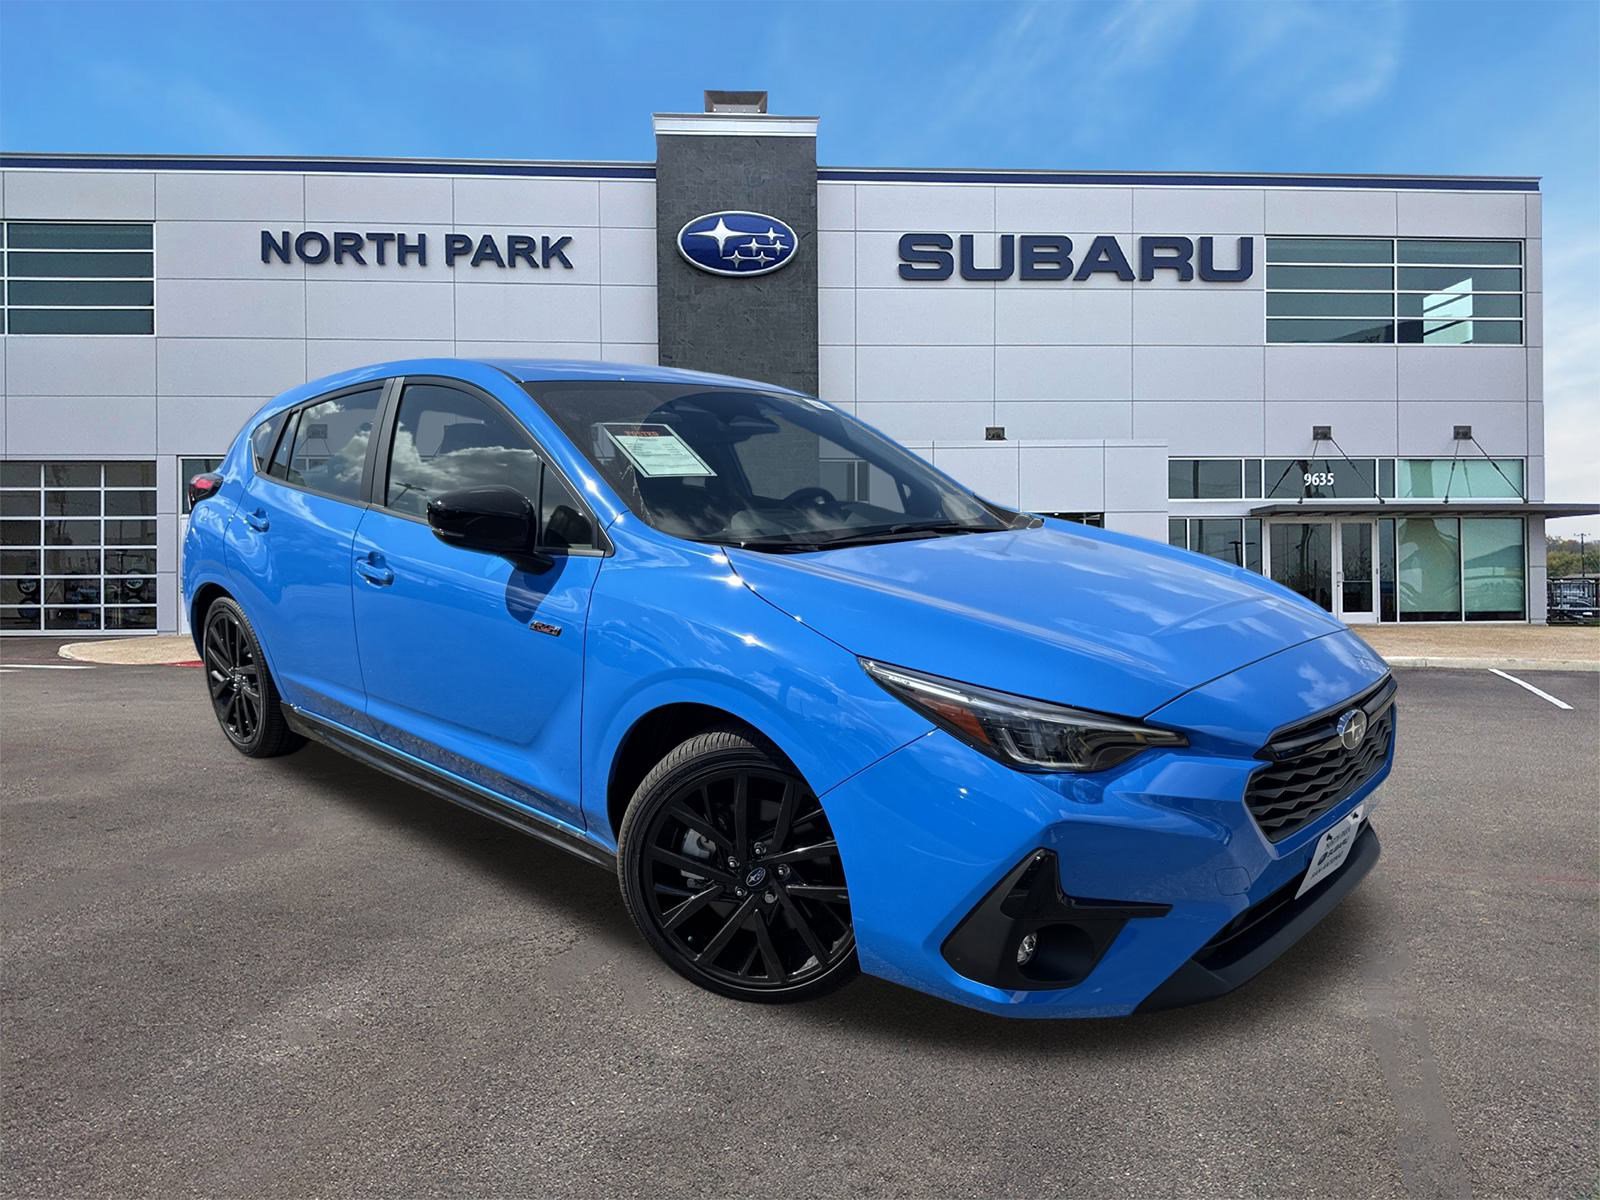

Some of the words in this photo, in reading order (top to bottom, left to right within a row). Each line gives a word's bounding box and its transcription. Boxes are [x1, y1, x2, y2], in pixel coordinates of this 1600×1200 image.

[260, 230, 428, 265] NORTH
[444, 233, 574, 269] PARK
[898, 233, 1254, 282] SUBARU
[1303, 472, 1335, 486] 9635
